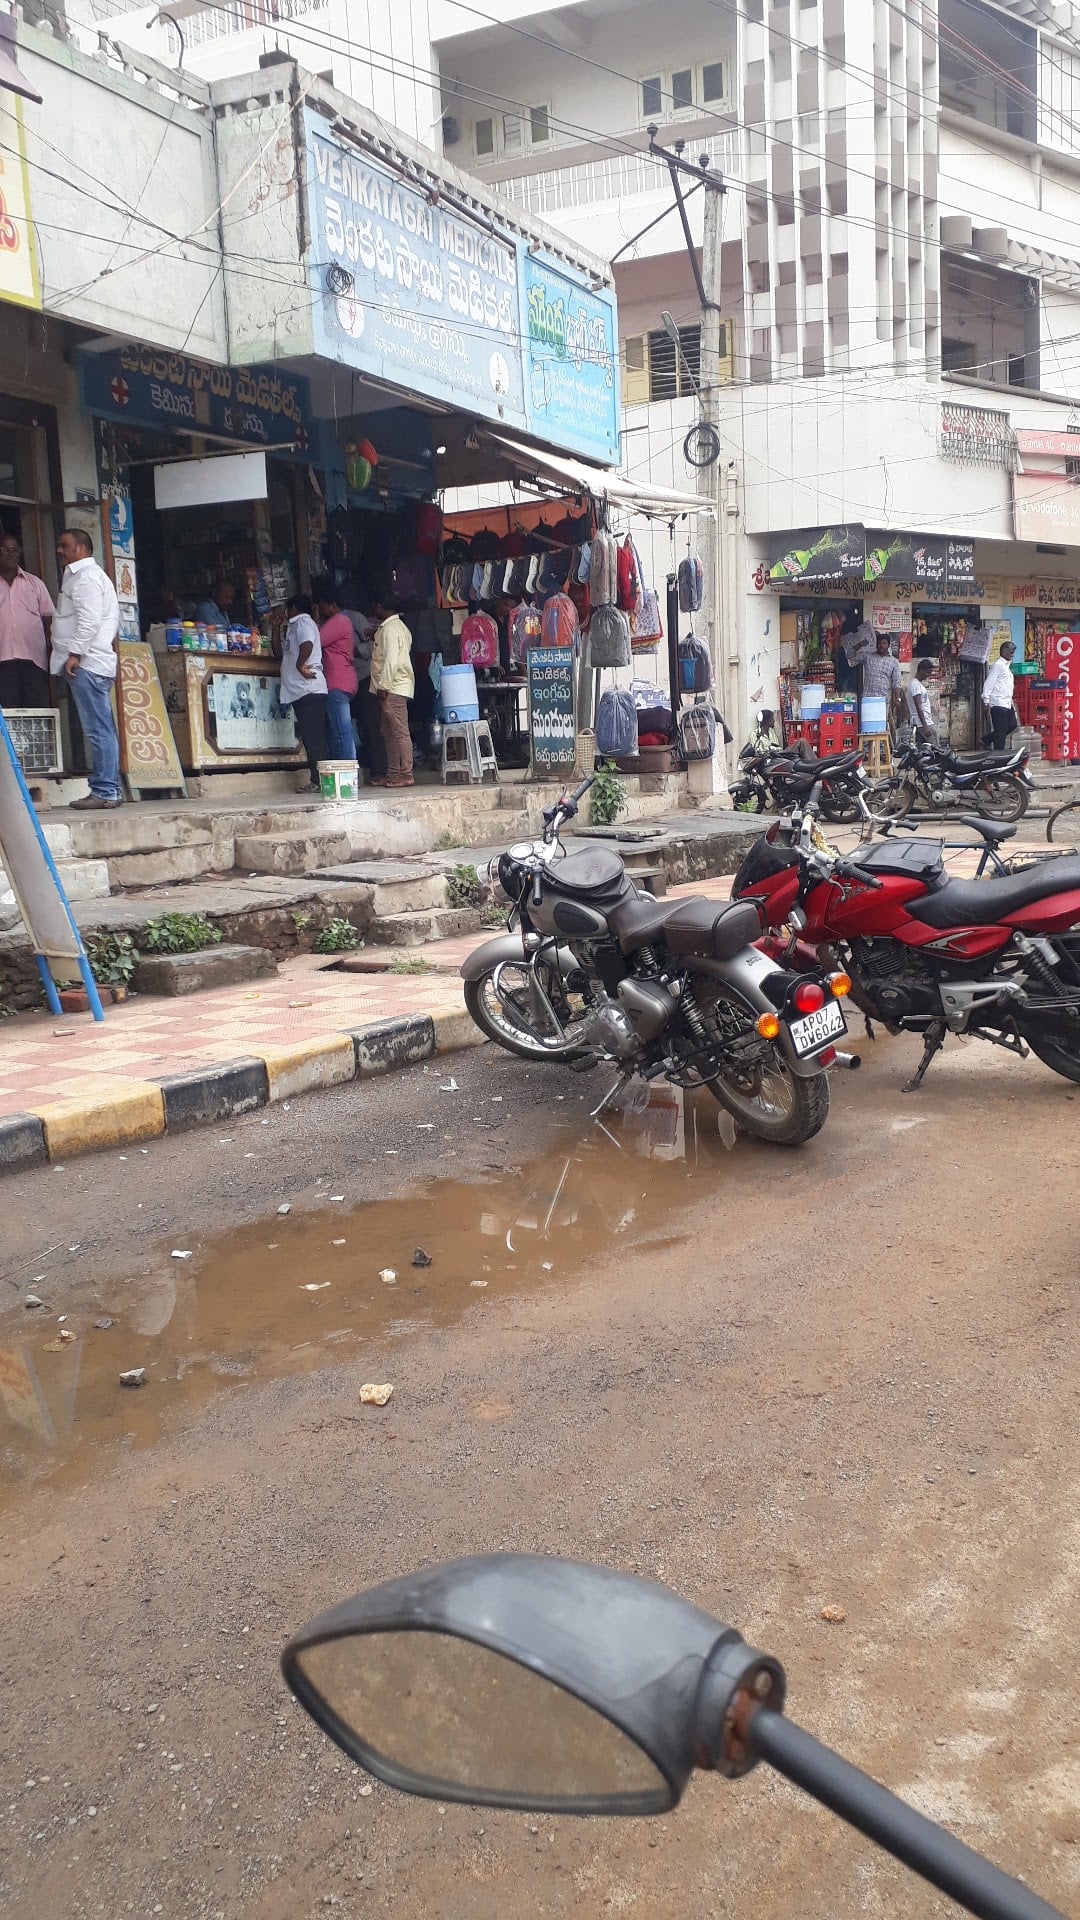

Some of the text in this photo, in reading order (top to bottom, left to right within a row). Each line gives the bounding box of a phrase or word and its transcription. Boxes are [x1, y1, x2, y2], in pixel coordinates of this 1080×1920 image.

[313, 142, 434, 243] VENKATASAI
[439, 216, 516, 286] MEDICALS
[1030, 502, 1066, 517] vodafone
[532, 667, 570, 682] మెడికల్స్
[533, 683, 570, 702] ఇంగ్లీషు
[532, 707, 574, 739] మందులు
[800, 1016, 843, 1048] DW6042
[802, 1008, 828, 1033] AP07
